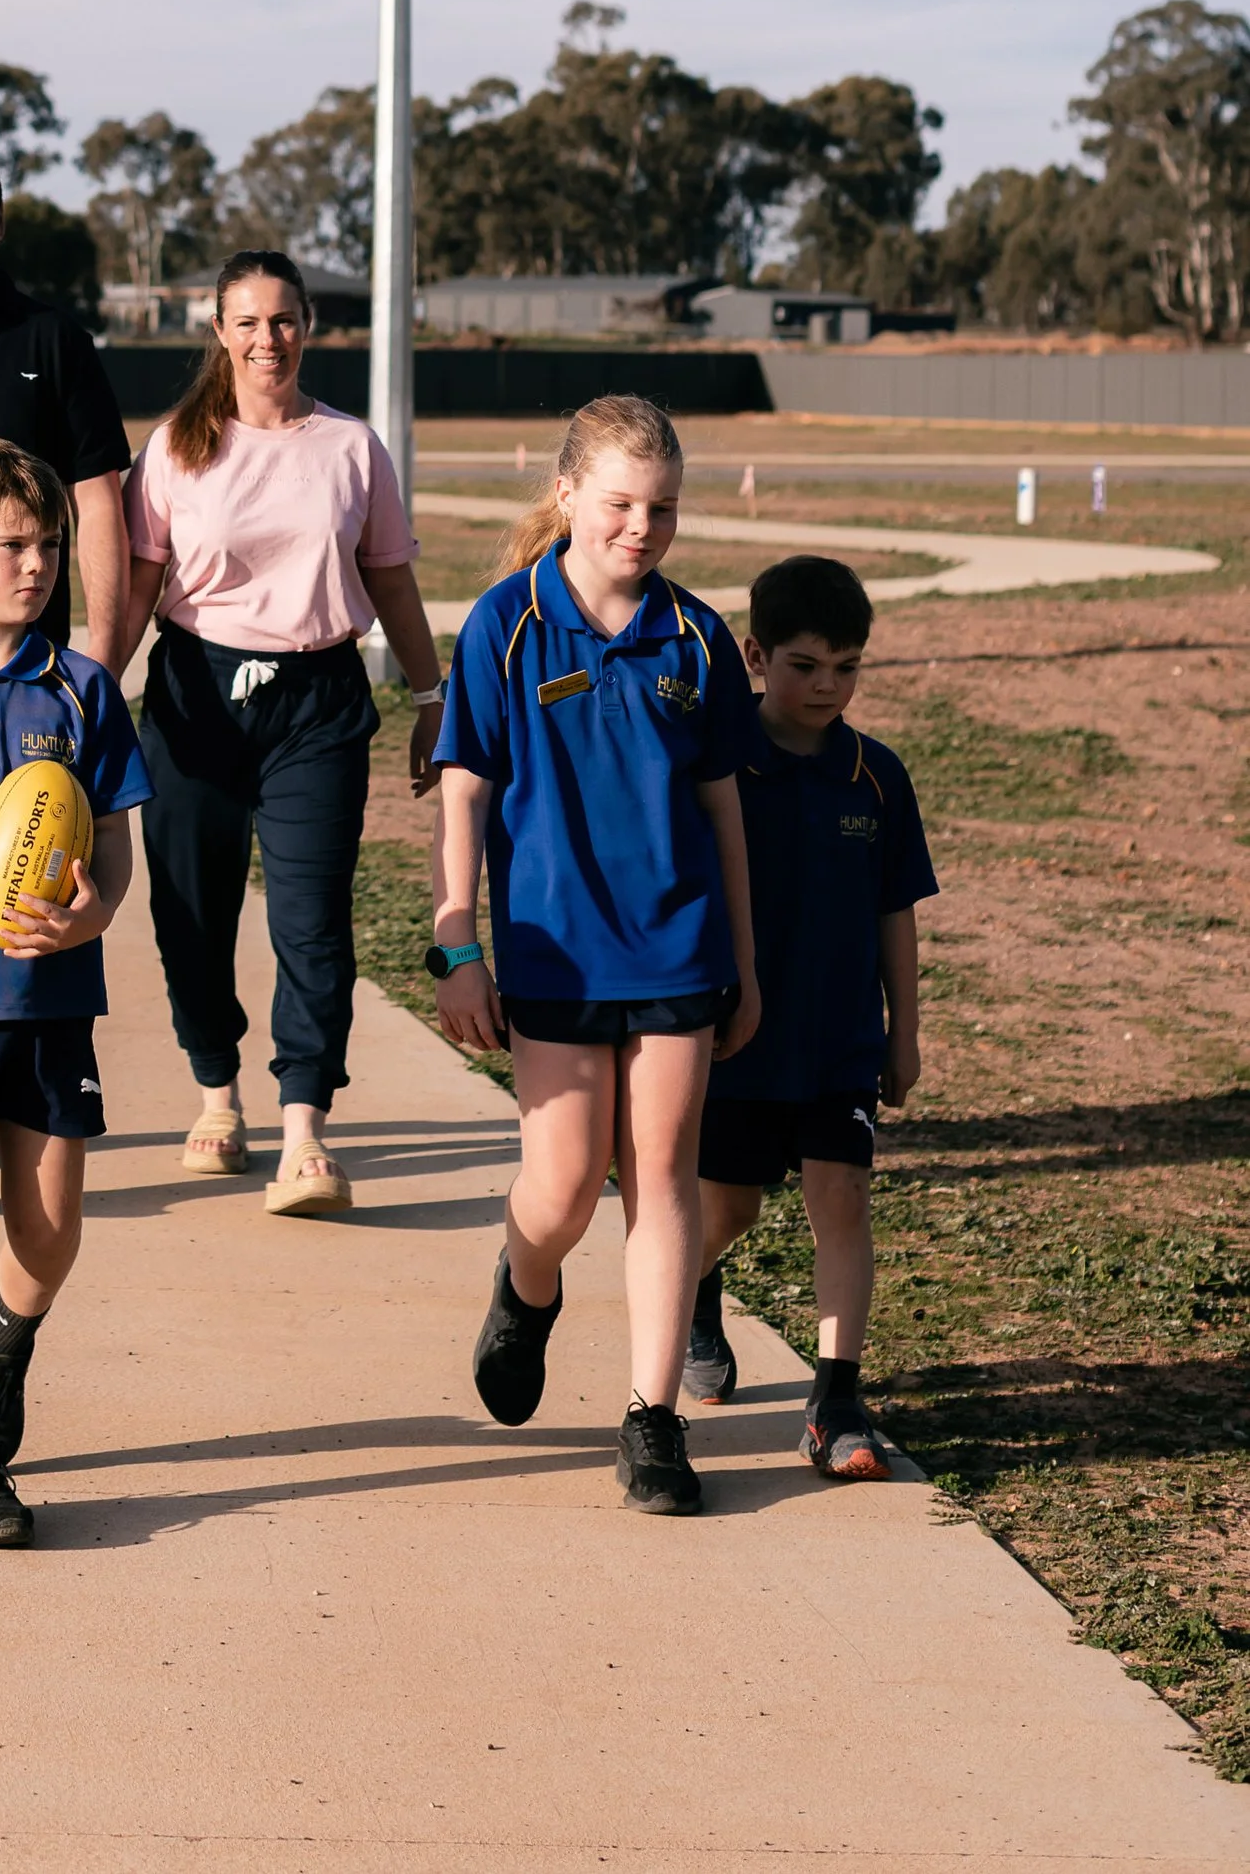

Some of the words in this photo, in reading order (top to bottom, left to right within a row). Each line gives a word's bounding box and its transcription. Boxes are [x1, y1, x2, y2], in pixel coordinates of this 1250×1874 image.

[21, 732, 66, 753] HUNTLY
[22, 790, 49, 850] SPORTS
[839, 815, 870, 831] HUNT
[32, 845, 45, 876] AUSTRALIA
